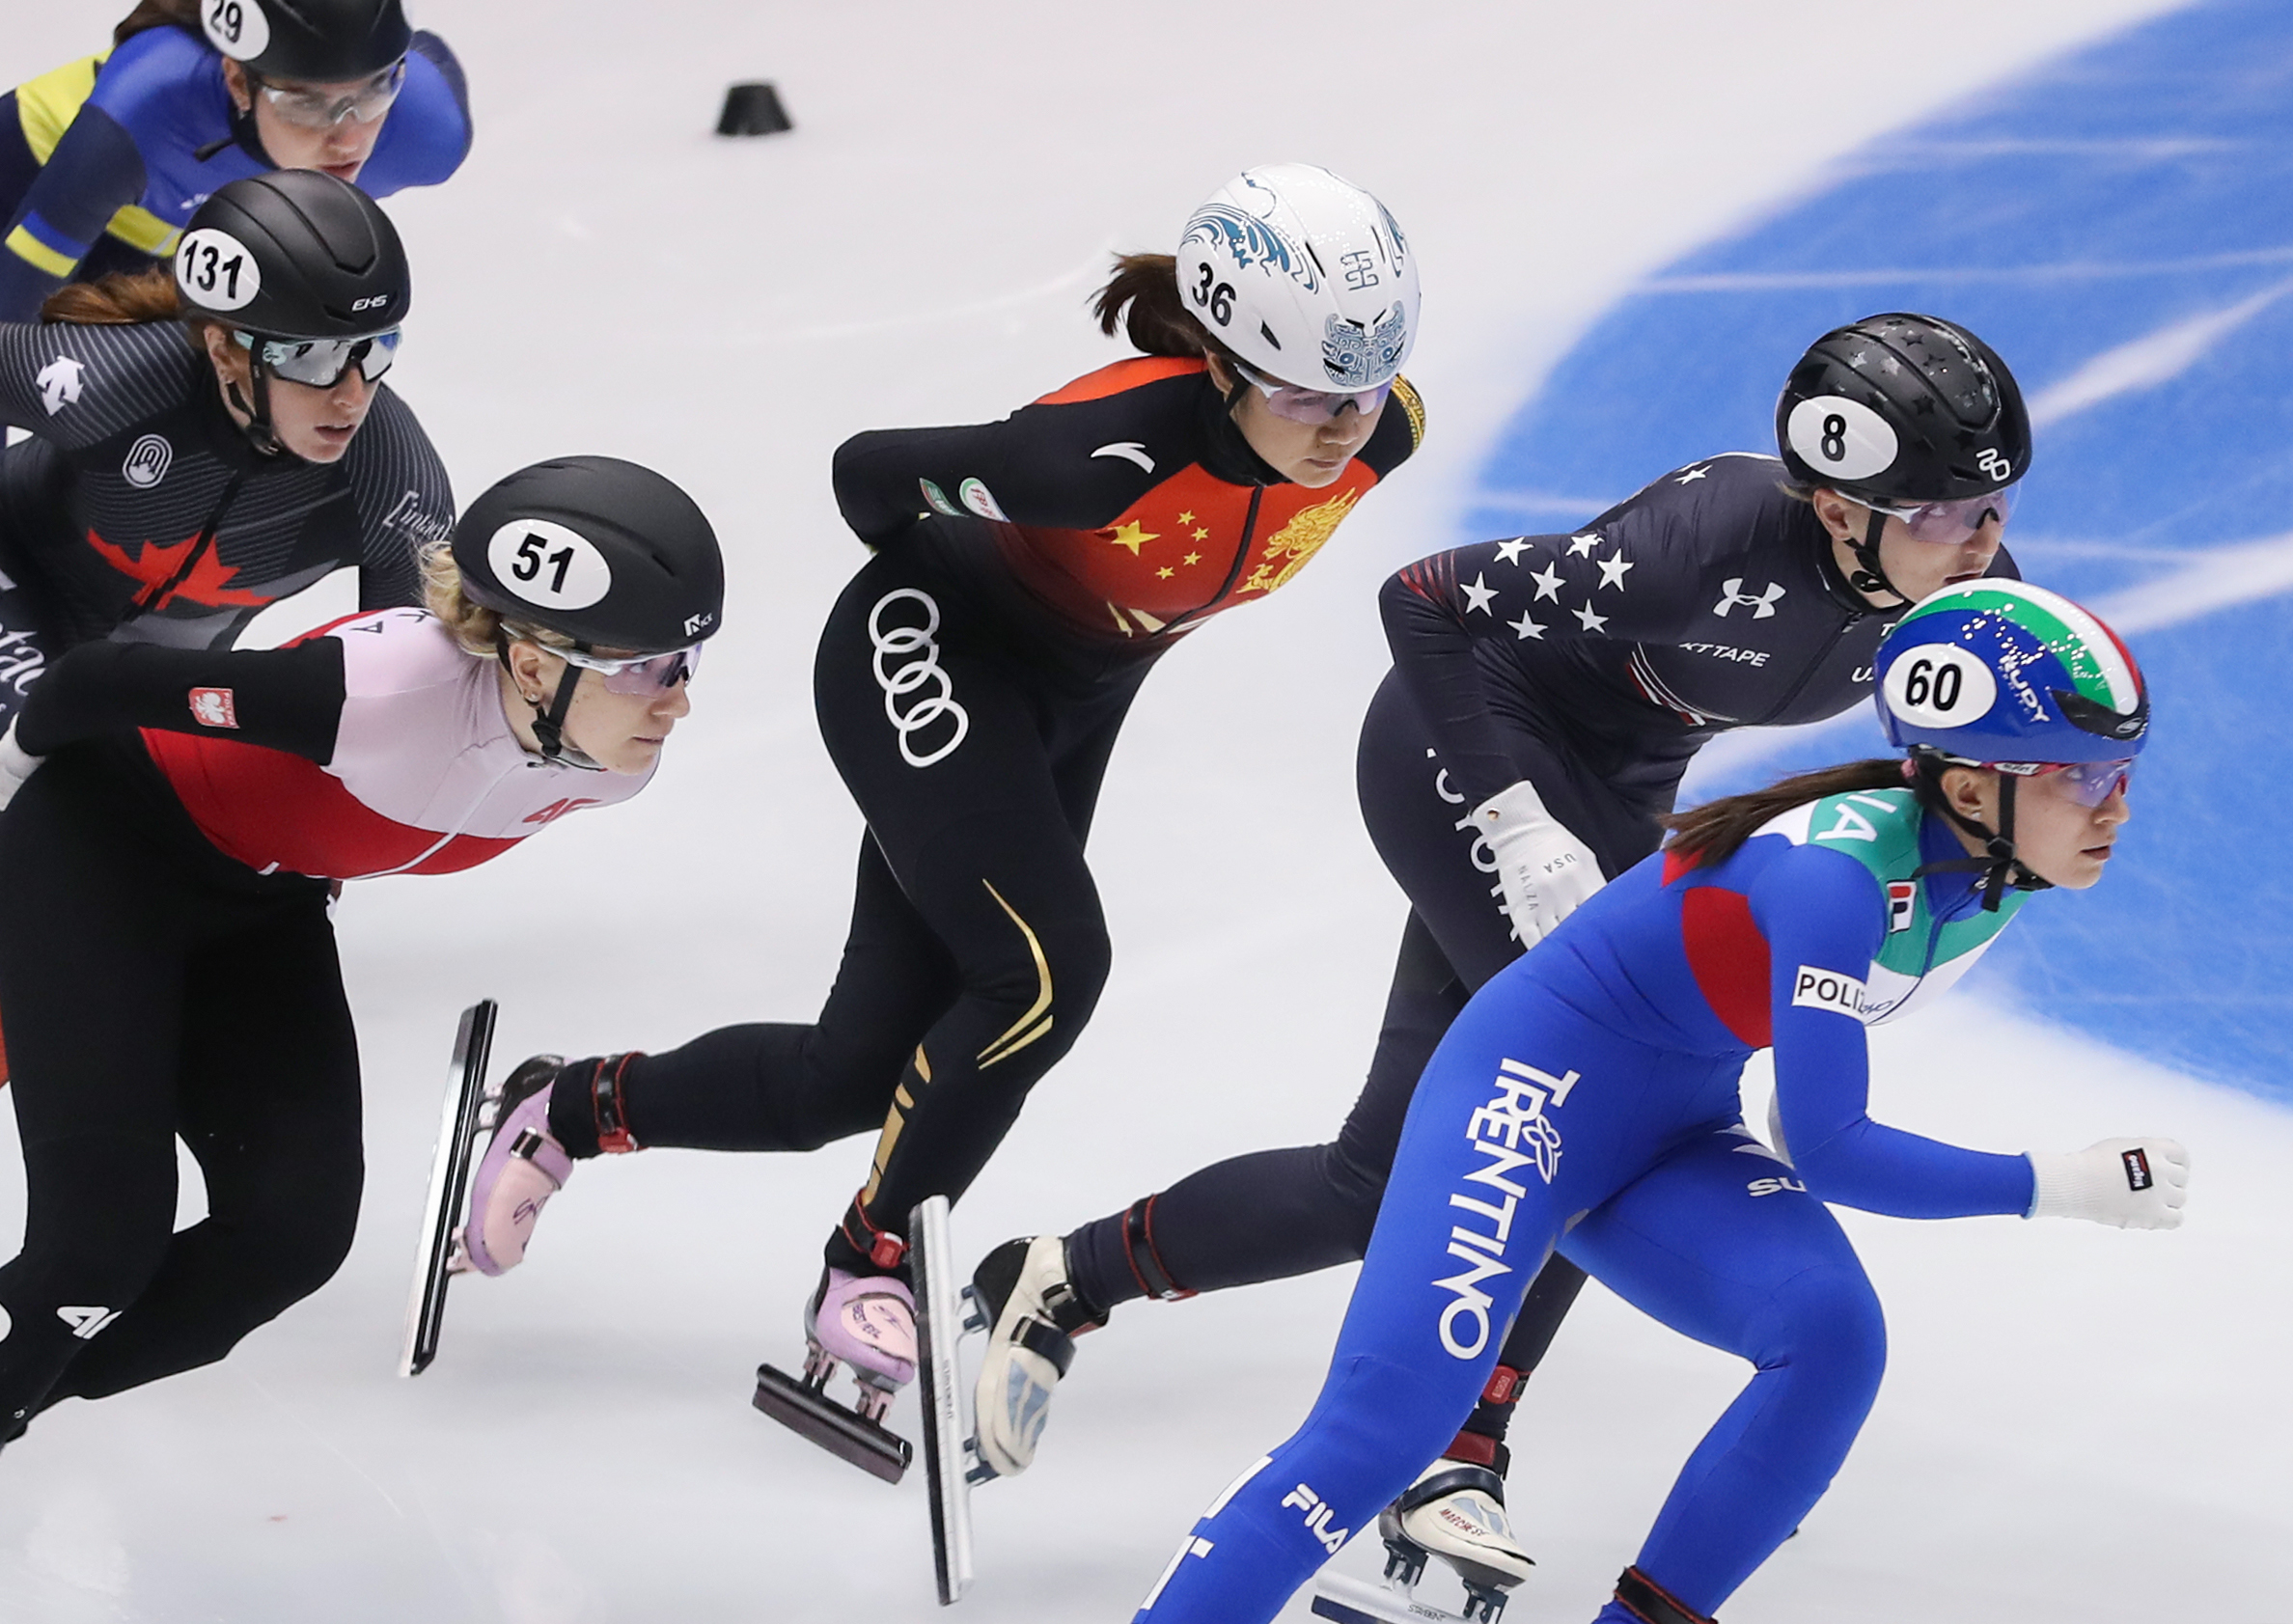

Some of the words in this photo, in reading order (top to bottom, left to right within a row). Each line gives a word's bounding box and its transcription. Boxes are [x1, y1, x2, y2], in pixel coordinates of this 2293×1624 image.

[183, 239, 243, 300] 131
[1192, 261, 1237, 327] 36
[1820, 413, 1846, 462] 8
[511, 533, 575, 594] 51
[1713, 645, 1771, 668] TAPE
[1905, 659, 1962, 712] 60
[1543, 852, 1577, 873] USA
[1431, 1058, 1581, 1361] TRENTINO
[1281, 1482, 1349, 1555] FILA
